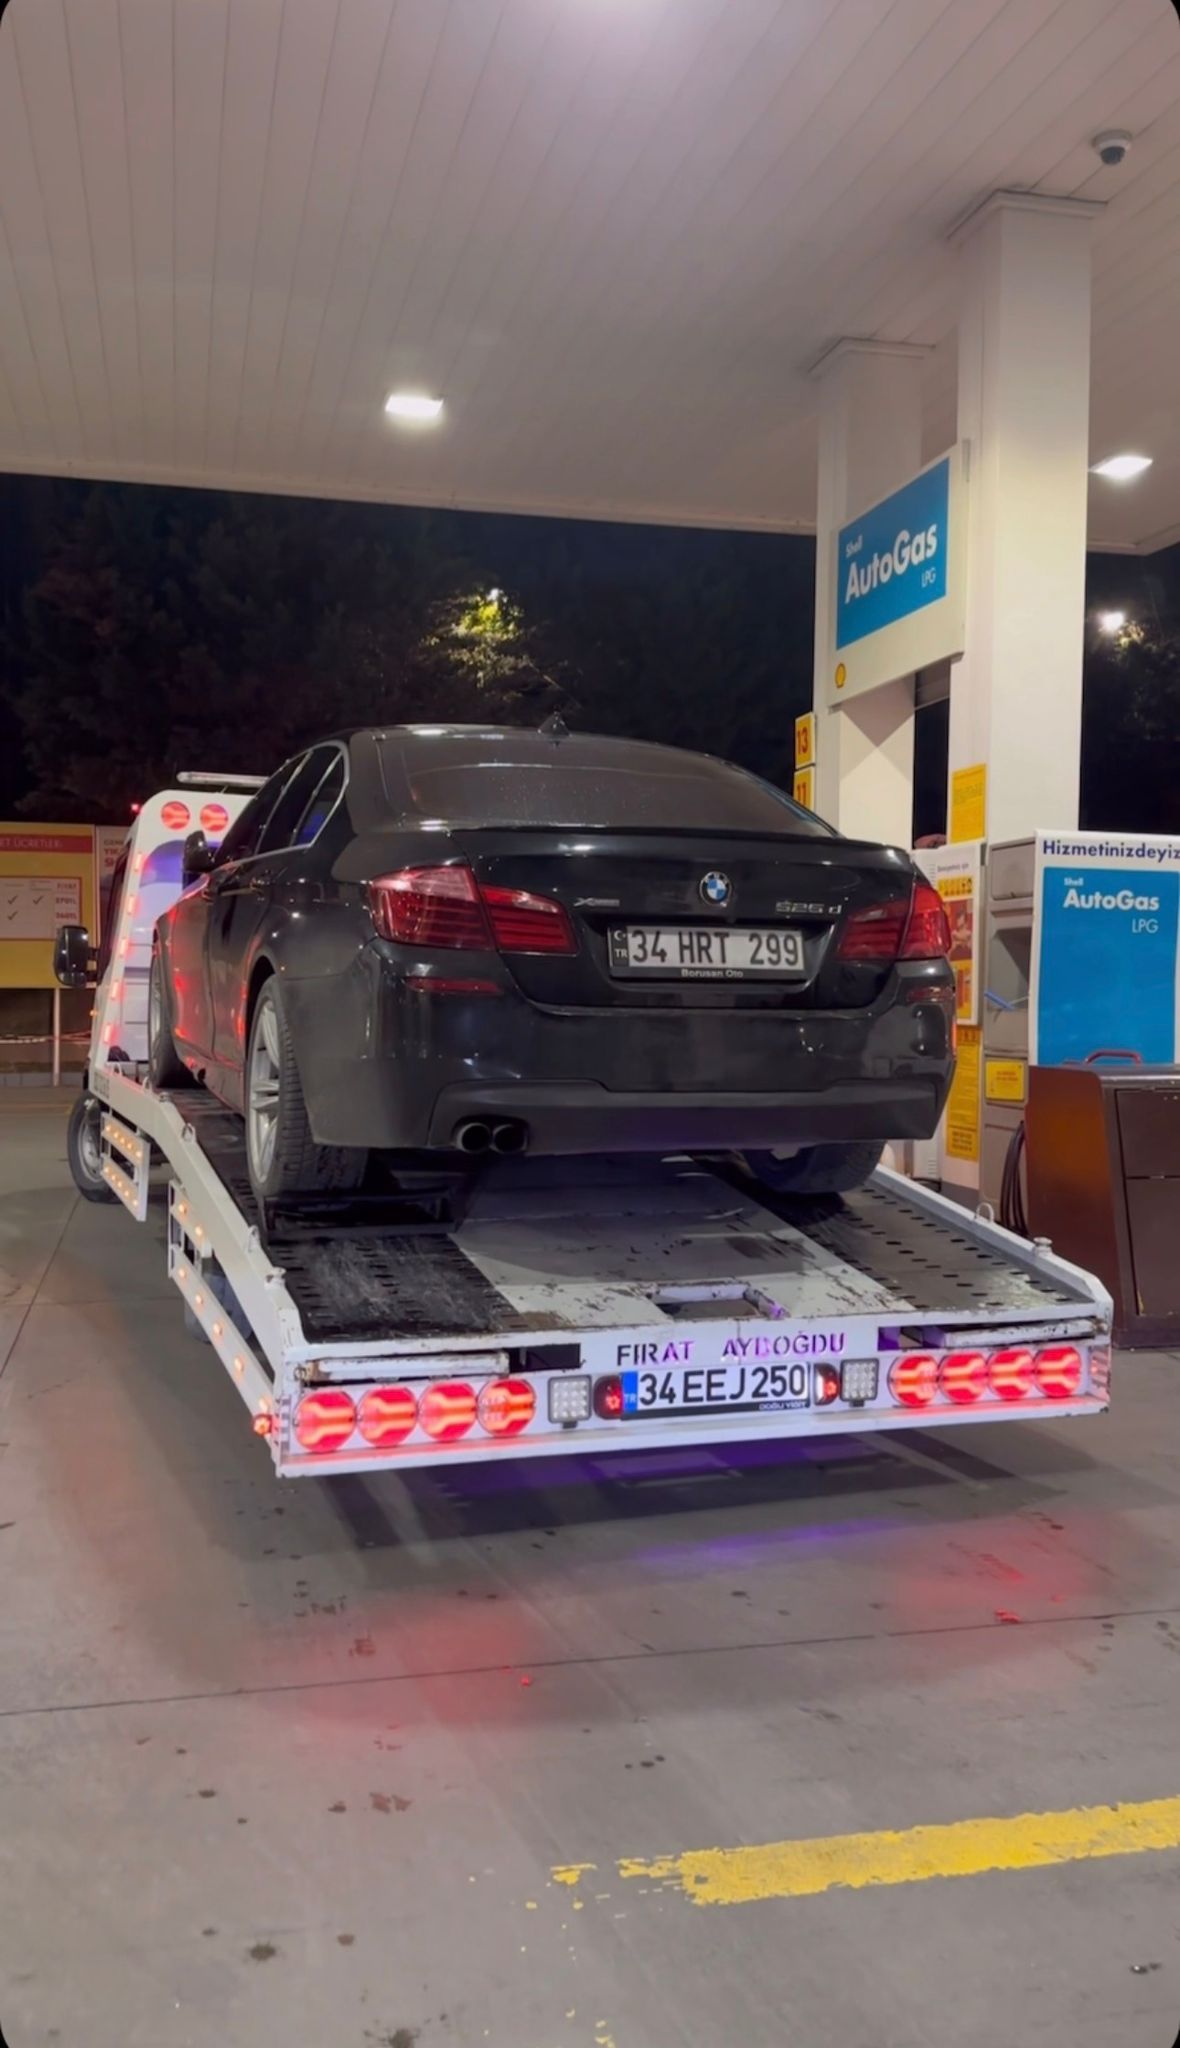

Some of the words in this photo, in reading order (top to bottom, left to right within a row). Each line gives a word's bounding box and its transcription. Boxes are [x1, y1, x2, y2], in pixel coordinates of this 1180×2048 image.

[845, 523, 938, 604] AutoGas
[921, 566, 937, 589] LPG
[797, 726, 808, 755] 13
[1043, 839, 1180, 863] Hizmetinizdeyiz
[1063, 877, 1084, 887] Shell
[1063, 888, 1160, 911] AutoGas
[1131, 919, 1159, 934] LPG
[614, 948, 628, 958] TR
[631, 929, 668, 963] 34
[678, 930, 730, 965] HRT
[749, 933, 799, 966] 299
[681, 968, 724, 978] Borusan
[726, 969, 744, 978] Oto
